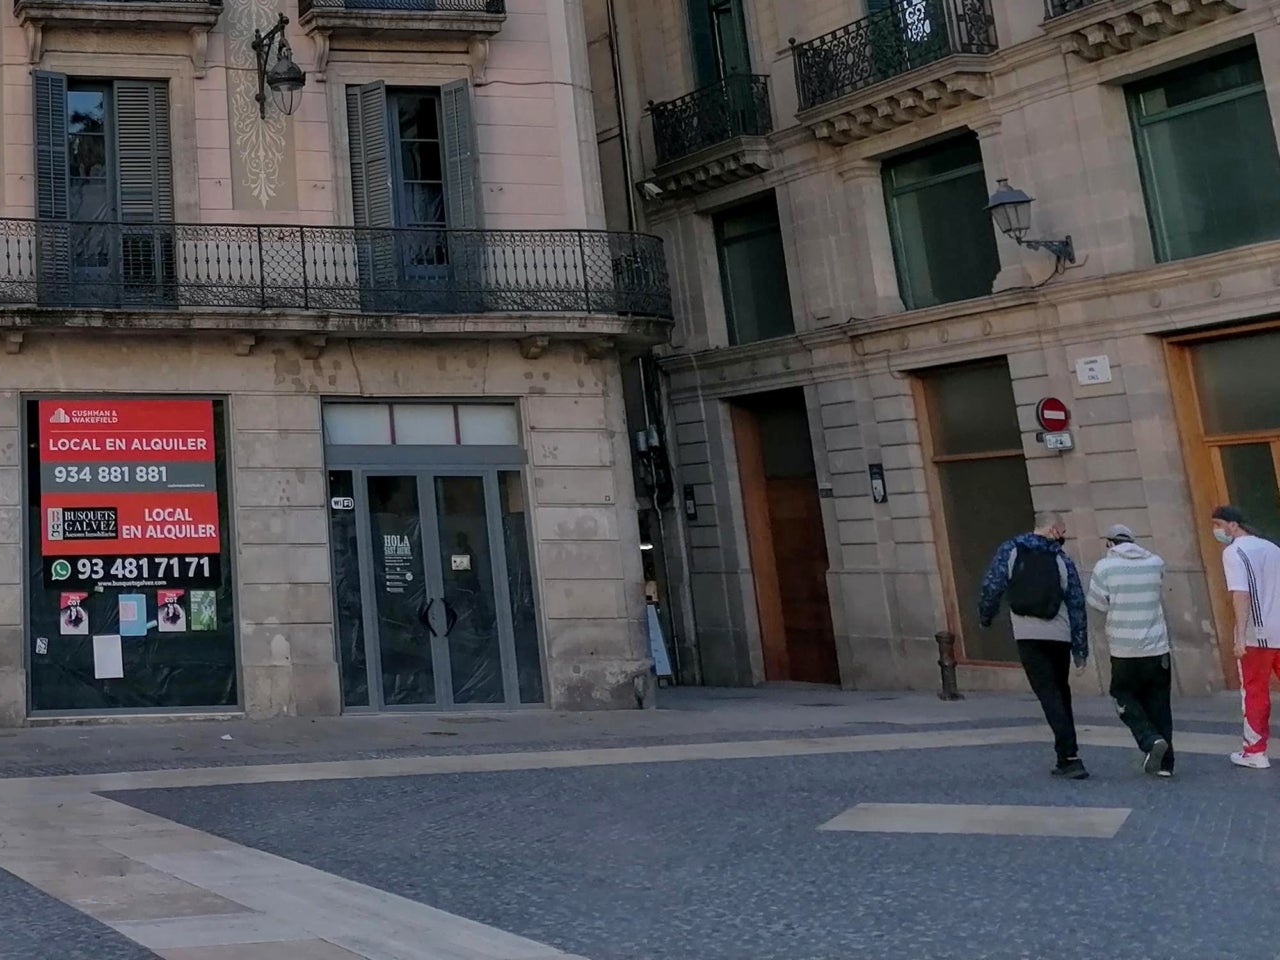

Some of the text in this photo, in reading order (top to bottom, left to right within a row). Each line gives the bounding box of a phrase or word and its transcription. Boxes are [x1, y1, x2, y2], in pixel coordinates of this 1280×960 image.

[49, 438, 207, 451] LOCAL EN ALQUILER
[54, 466, 167, 483] 934 881 881
[64, 510, 116, 522] BUSQUETS
[144, 508, 193, 522] LOCAL
[64, 521, 116, 531] GALVEZ
[122, 524, 217, 540] EN ALQUILER
[384, 535, 410, 547] HOLA
[77, 556, 210, 580] 93 481 71 71
